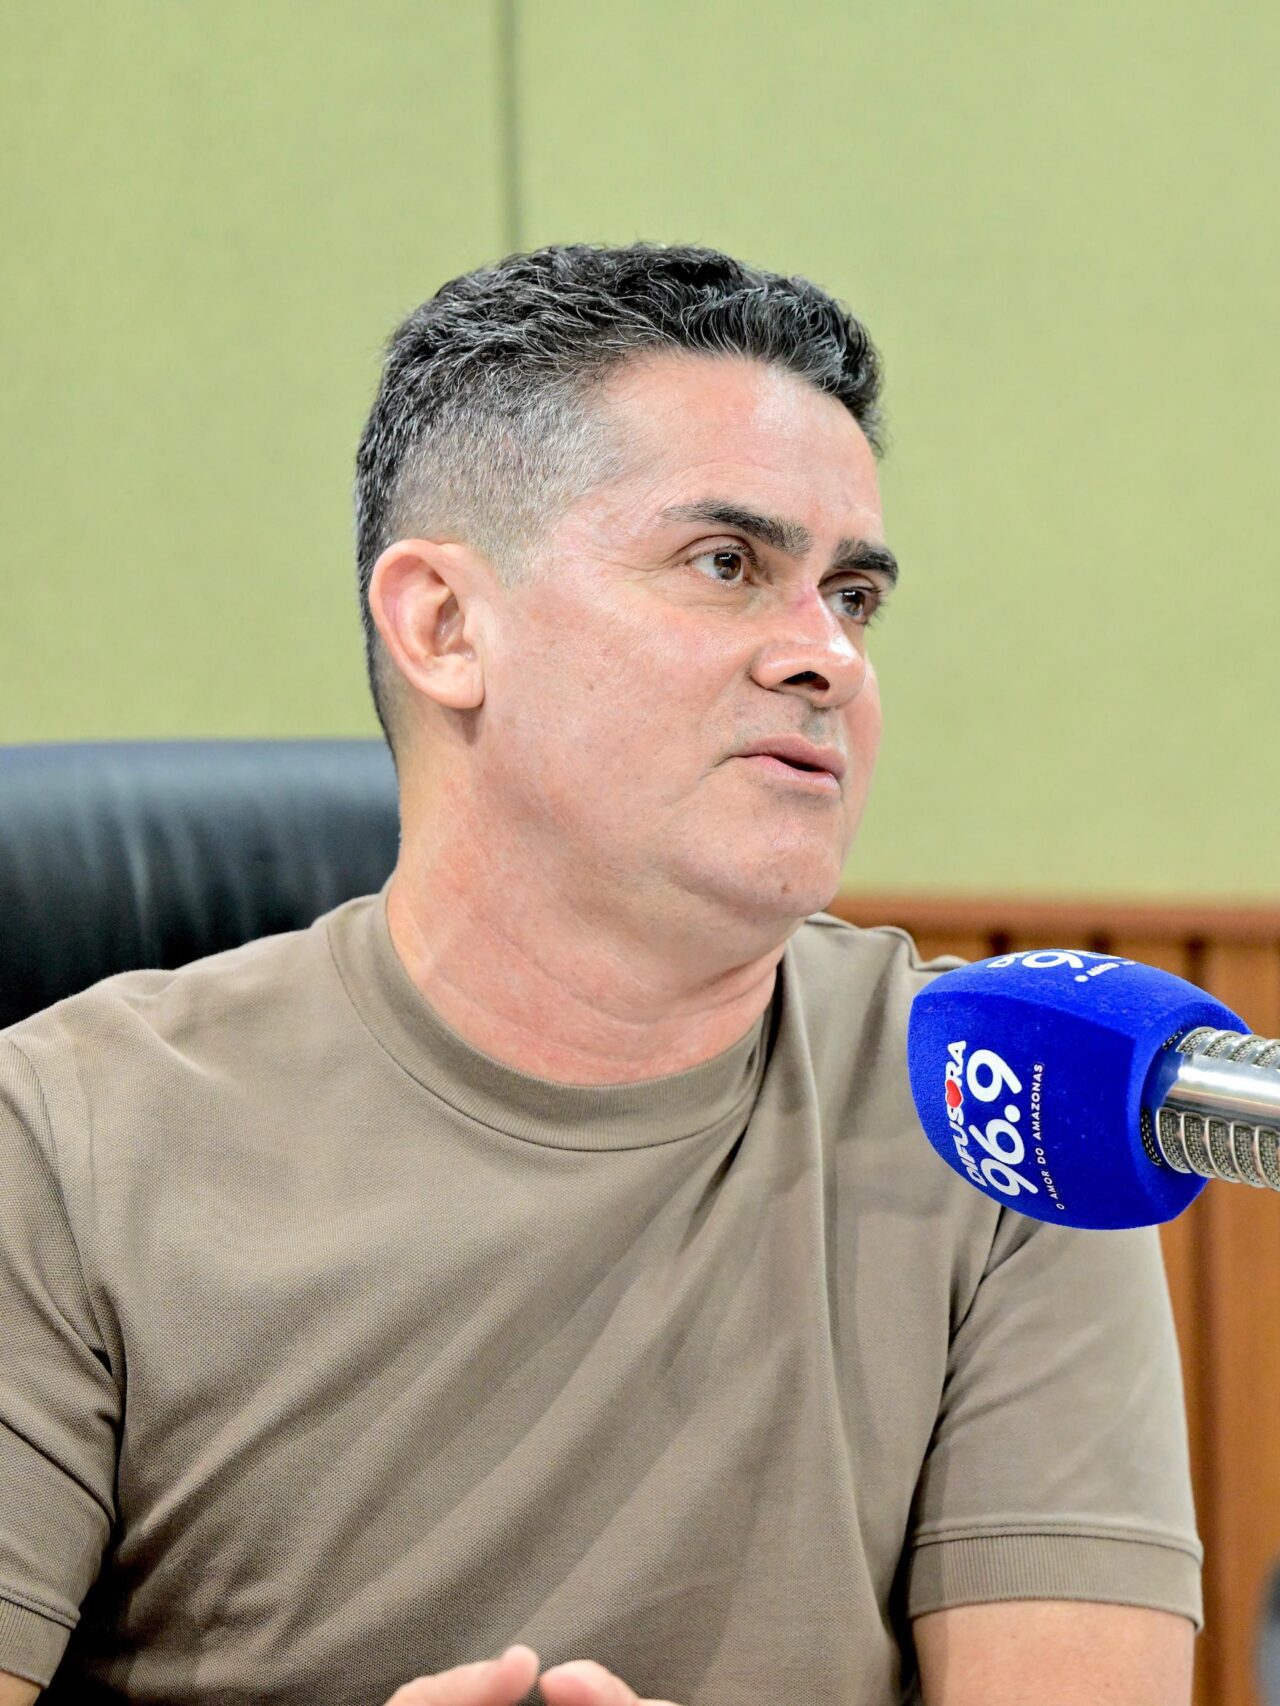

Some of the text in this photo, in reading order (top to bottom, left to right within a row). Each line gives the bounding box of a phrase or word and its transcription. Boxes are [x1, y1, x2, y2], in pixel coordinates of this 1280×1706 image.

[966, 1049, 1039, 1196] 96.9
[1030, 1063, 1044, 1141] AMAZONAS
[1035, 1147, 1047, 1165] DO
[1041, 1170, 1058, 1200] AMOR
